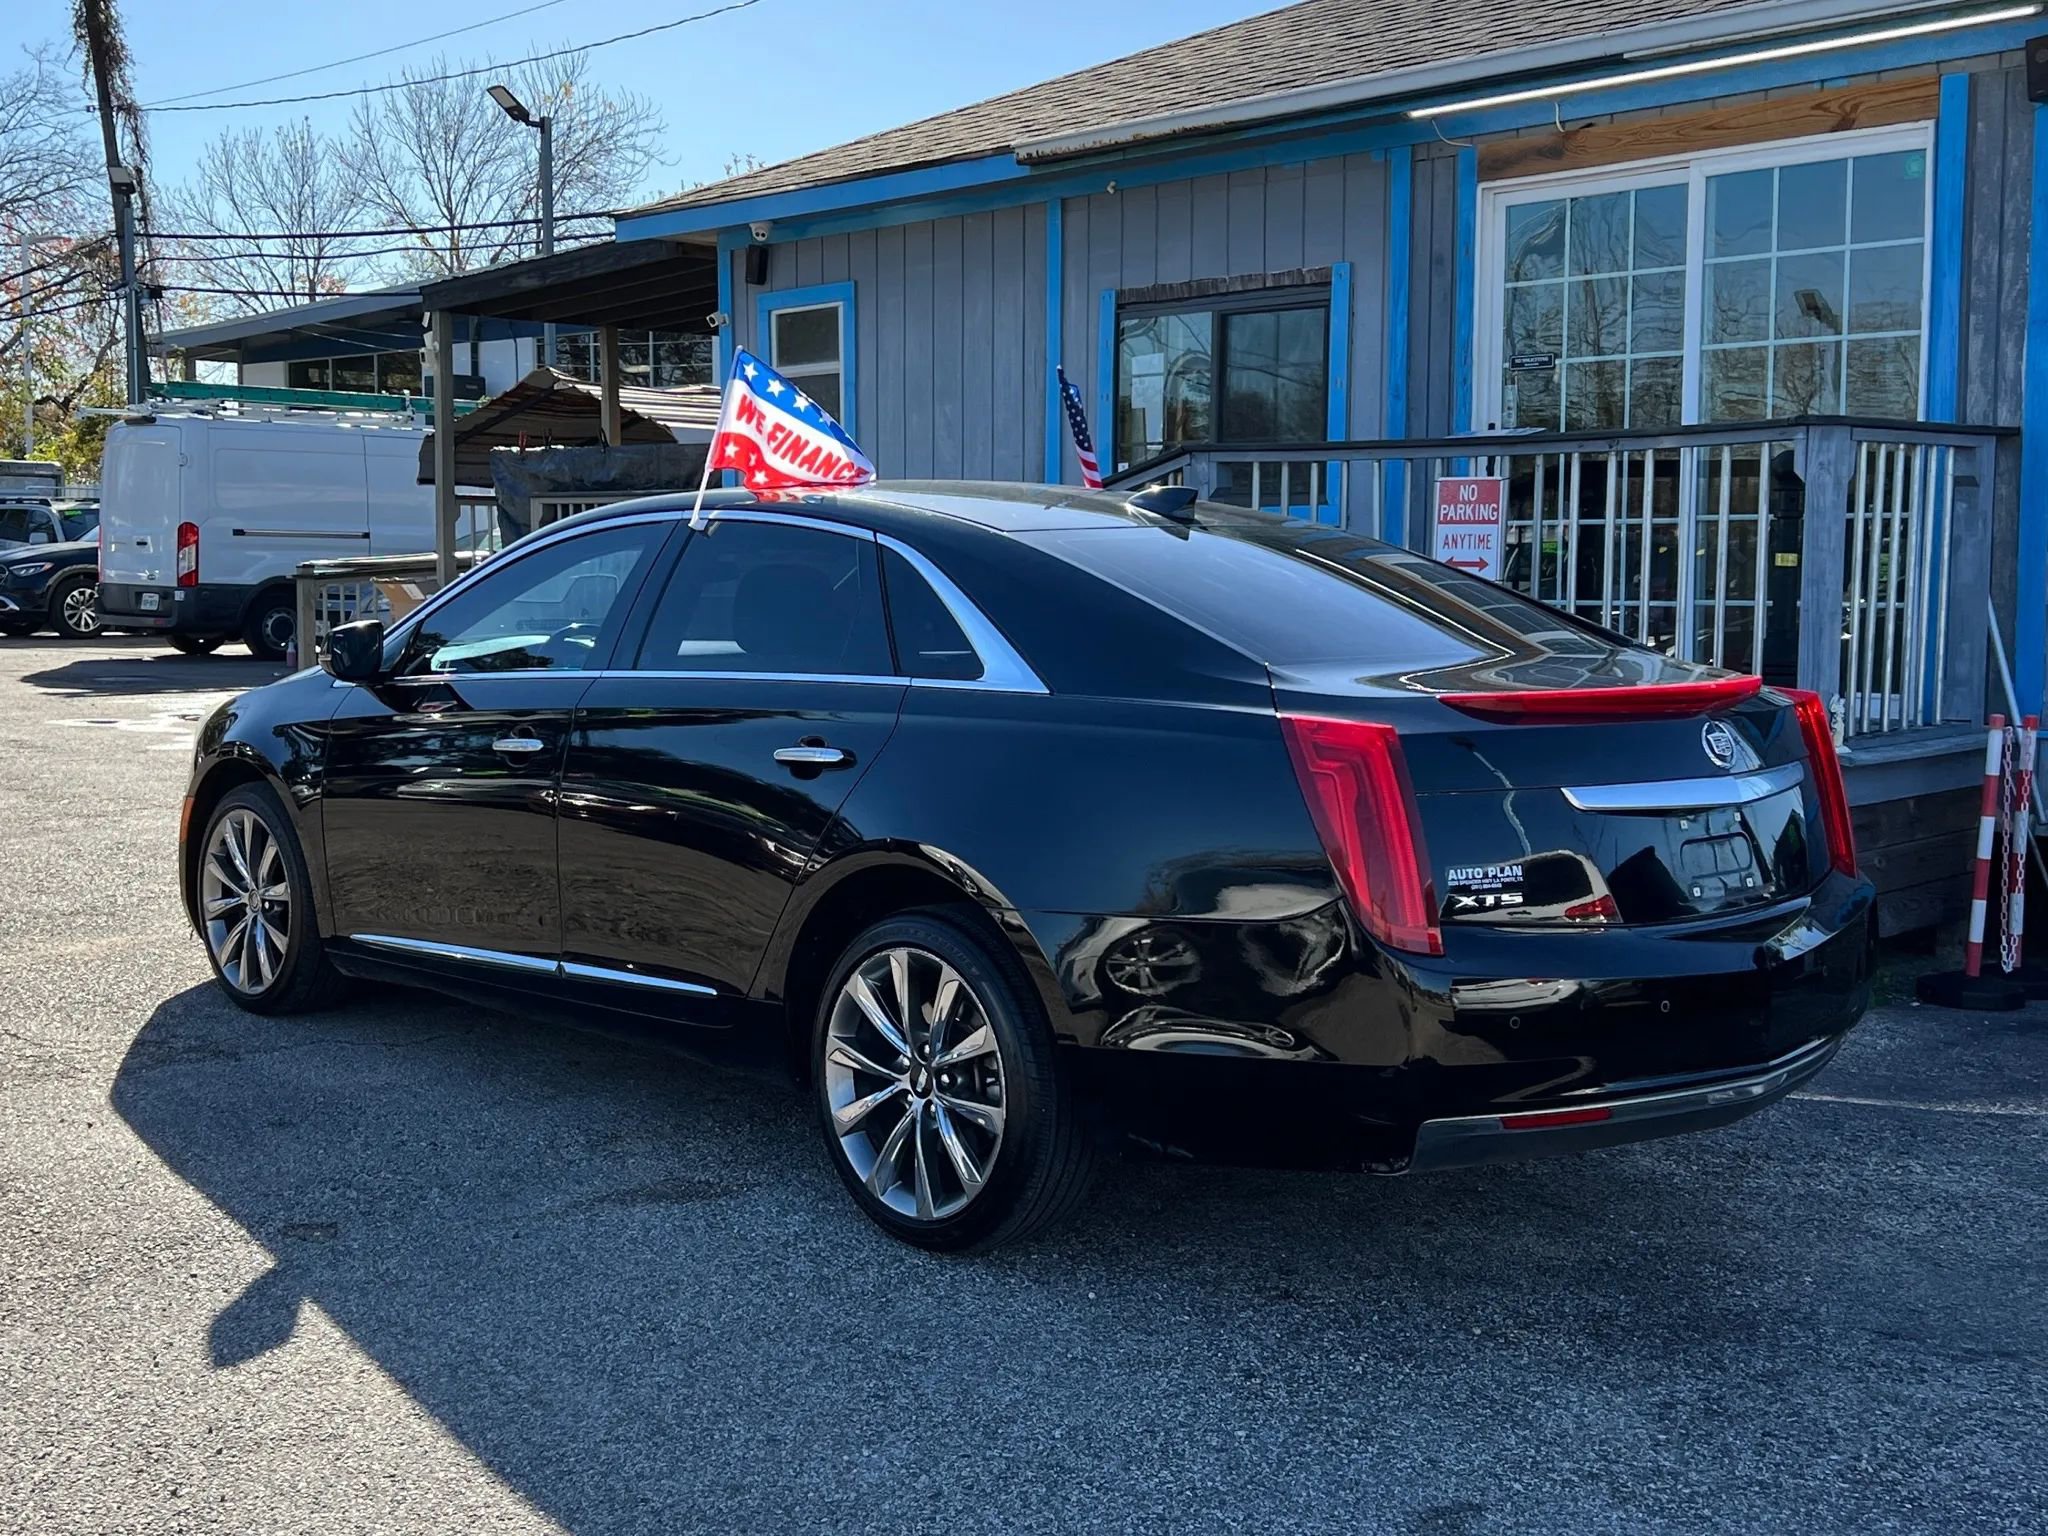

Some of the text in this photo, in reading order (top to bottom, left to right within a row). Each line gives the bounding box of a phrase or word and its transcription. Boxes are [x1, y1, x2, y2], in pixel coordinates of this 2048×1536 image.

[736, 393, 870, 481] WE FINANCE
[1459, 484, 1478, 501] NO
[1440, 503, 1498, 521] PARKING
[1442, 533, 1492, 550] ANYTIME
[1448, 865, 1523, 881] AUTO PLAN
[1454, 892, 1524, 908] XTS
